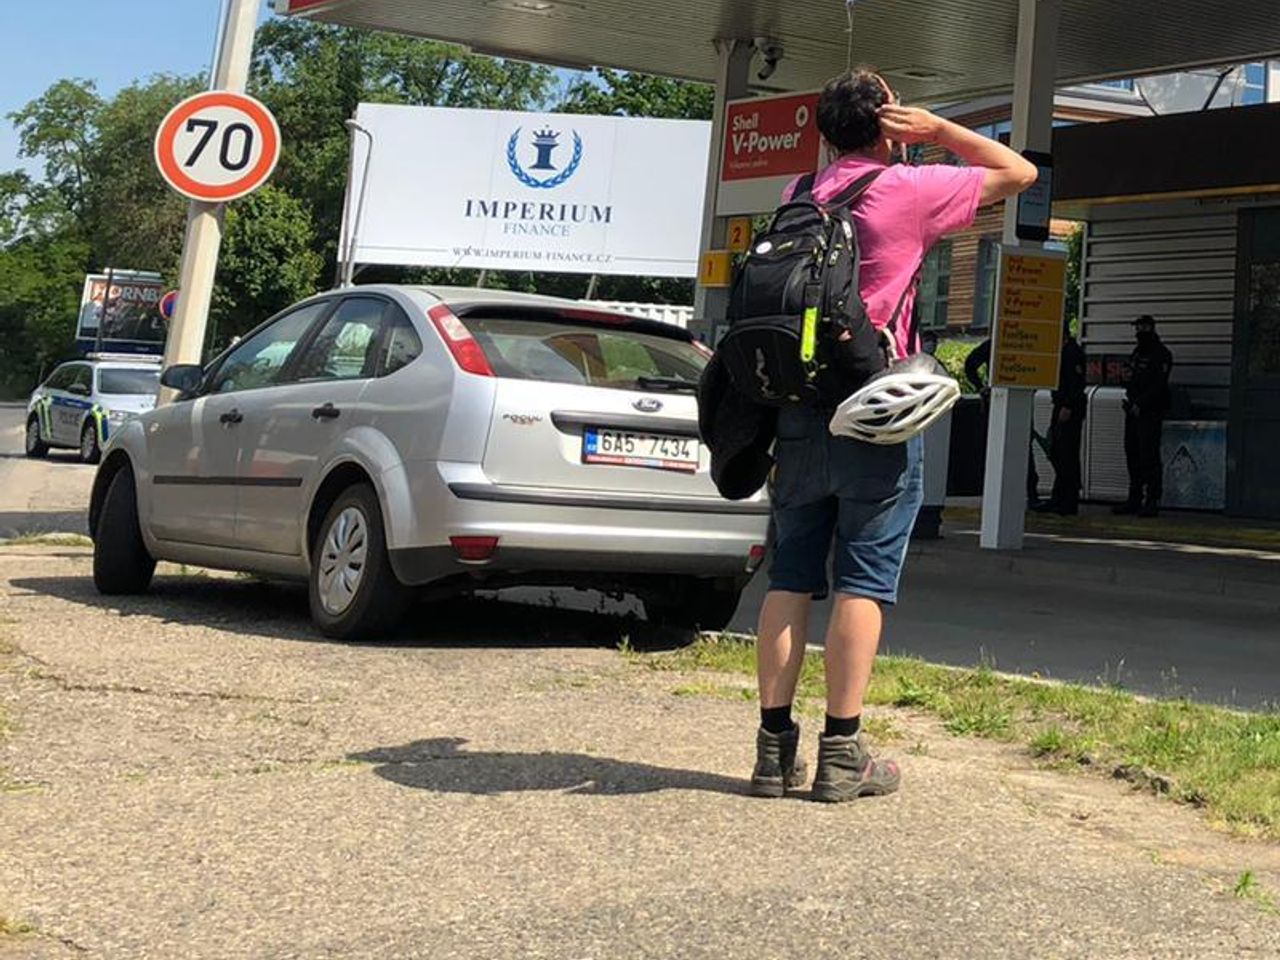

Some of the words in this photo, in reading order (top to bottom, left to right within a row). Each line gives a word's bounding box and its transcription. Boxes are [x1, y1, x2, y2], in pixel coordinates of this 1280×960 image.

[732, 112, 759, 132] Shell
[184, 118, 254, 171] 70
[731, 131, 801, 156] V-Power
[464, 199, 614, 224] IMPERIUM
[503, 223, 571, 237] FINANCE
[733, 227, 741, 244] 2
[601, 431, 635, 453] 6A5
[648, 436, 690, 459] 7434
